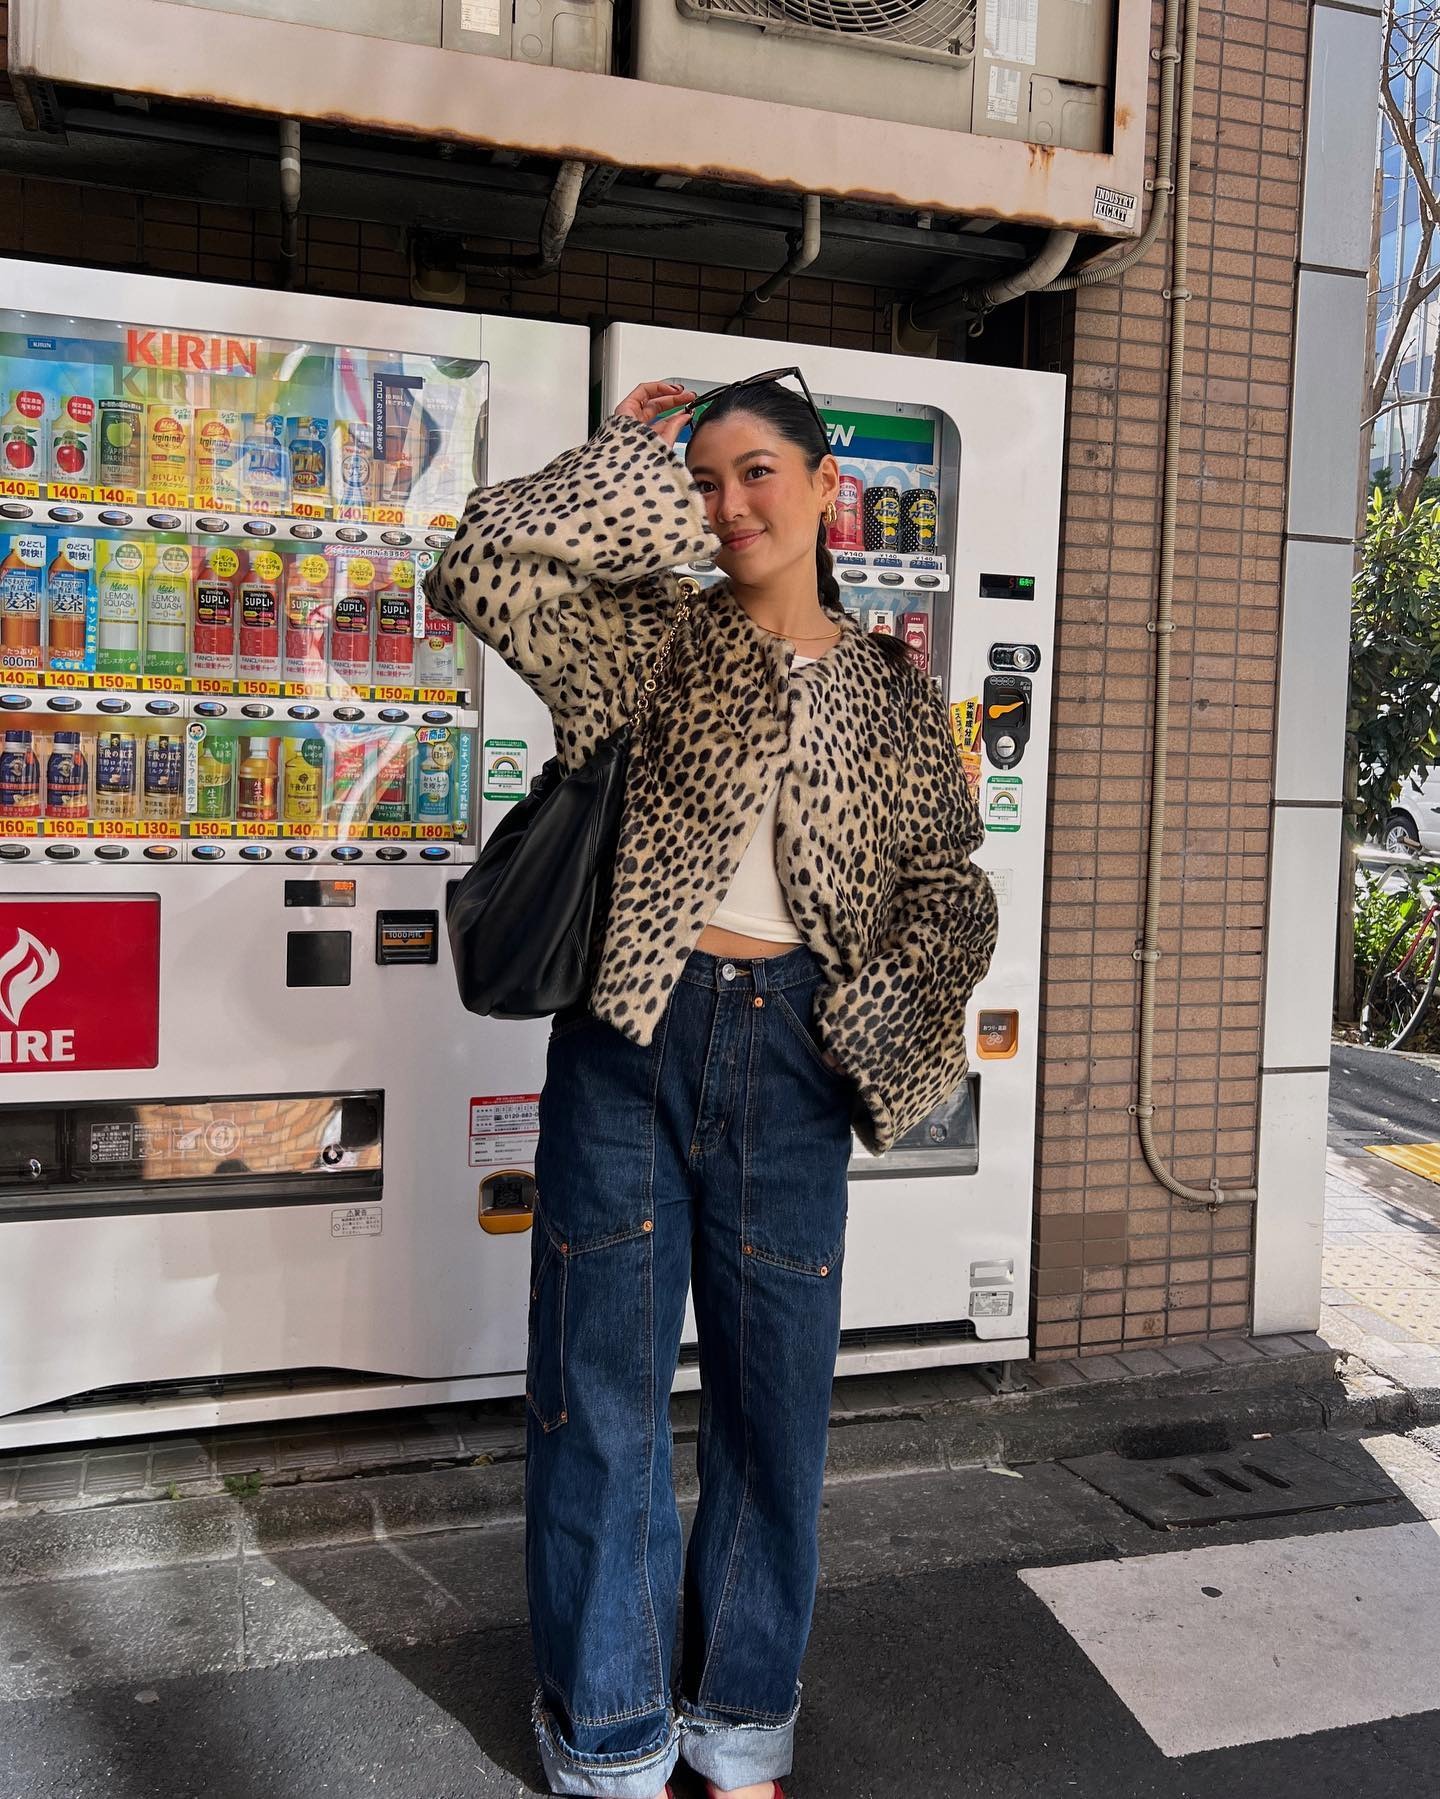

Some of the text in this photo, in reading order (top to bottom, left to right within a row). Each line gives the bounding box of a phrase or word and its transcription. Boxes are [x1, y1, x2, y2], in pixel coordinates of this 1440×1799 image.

[1096, 188, 1134, 207] INDUSTRY
[1097, 202, 1127, 221] KICKIT
[127, 329, 257, 376] KIRIN
[0, 481, 35, 497] 140円
[53, 485, 87, 500] 140円
[838, 489, 857, 498] ECTA
[100, 488, 133, 503] 140円
[152, 492, 185, 507] 140円
[199, 496, 232, 511] 140円
[879, 500, 897, 509] レモン
[916, 501, 935, 511] レモン
[19, 540, 46, 548] のどごし
[66, 543, 92, 551] のどごし
[20, 548, 43, 559] 爽快!
[68, 551, 90, 561] 爽快!
[5, 591, 36, 610] 麦茶
[53, 593, 83, 612] 麦茶
[105, 592, 134, 601] LEMON
[152, 595, 181, 603] LEMON
[200, 594, 230, 605] SUPLI+
[244, 597, 274, 608] SUPLI+
[104, 599, 135, 608] SQUASH
[151, 601, 182, 610] SQUASH
[338, 602, 366, 613] SUPLI+
[382, 604, 410, 615] SUPLI+
[7, 648, 33, 656] たっぷり
[2, 656, 38, 667] 600ml
[0, 672, 34, 684] 140円
[50, 674, 84, 686] 140円
[99, 676, 133, 689] 150円
[148, 678, 181, 690] 150円
[196, 680, 230, 693] 150円
[243, 682, 276, 695] 150円
[379, 687, 410, 699] 150円
[423, 689, 453, 701] 170円
[419, 727, 447, 741] 新商品
[252, 780, 264, 801] 生茶
[289, 782, 317, 792] 午後の紅茶
[423, 782, 447, 790] 免疫ケア
[187, 778, 197, 812] 免疫ケア
[206, 788, 219, 811] 生茶
[0, 821, 33, 833] 160円
[50, 821, 83, 834] 160円
[100, 822, 133, 834] 130円
[144, 822, 177, 835] 130円
[194, 823, 228, 835] 150円
[242, 823, 274, 836] 140円
[378, 825, 408, 837] 140円
[420, 825, 451, 837] 180円
[0, 1029, 76, 1063] IRE
